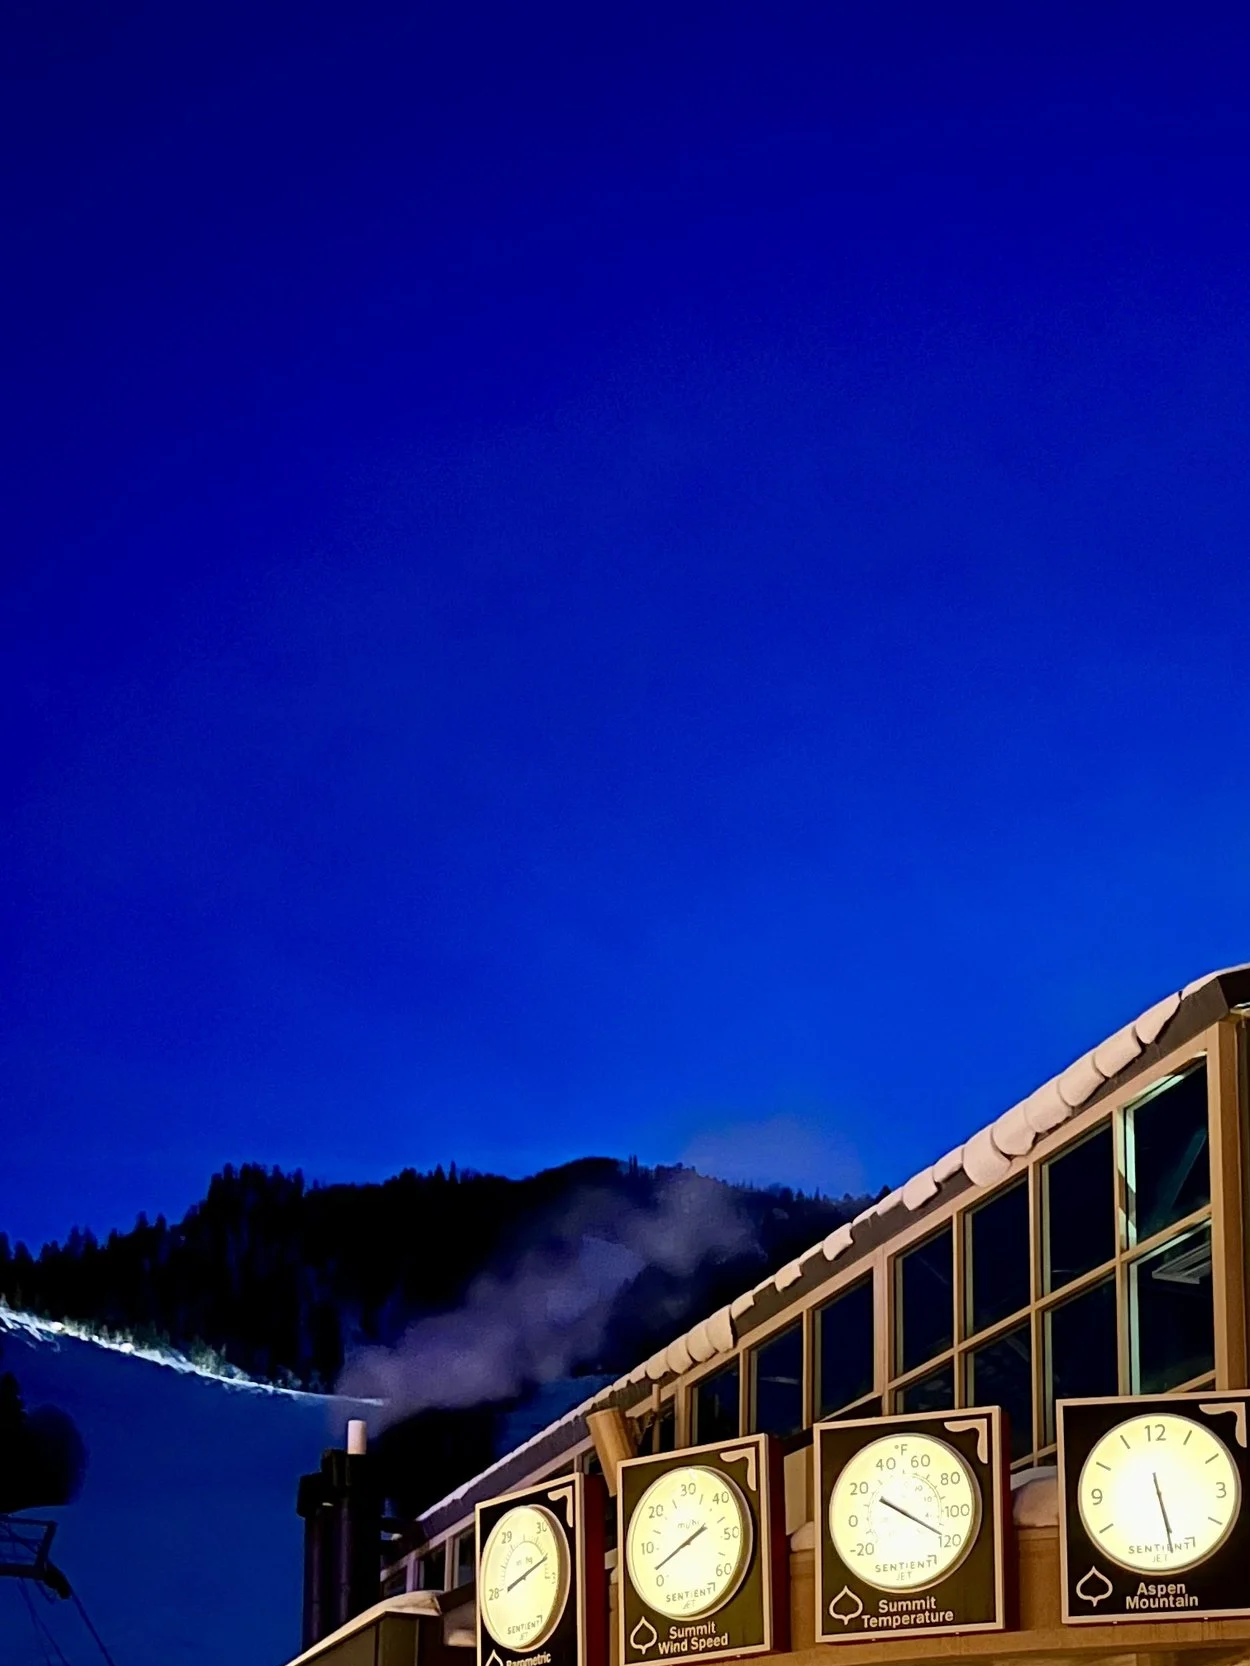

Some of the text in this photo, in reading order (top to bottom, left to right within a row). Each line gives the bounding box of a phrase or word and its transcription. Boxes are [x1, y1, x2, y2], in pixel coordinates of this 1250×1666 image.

[1144, 1424, 1167, 1442] 12
[876, 1457, 897, 1471] 40
[910, 1454, 931, 1468] 60
[940, 1471, 961, 1486] 80
[681, 1482, 697, 1497] 30
[849, 1481, 869, 1496] 20
[1215, 1482, 1227, 1499] 3
[712, 1491, 730, 1505] 40
[1091, 1488, 1103, 1505] 9
[648, 1504, 664, 1519] 20
[944, 1503, 970, 1518] 100
[848, 1514, 859, 1528] 0
[501, 1531, 513, 1545] 29
[723, 1526, 740, 1540] 50
[938, 1533, 962, 1548] 120
[641, 1541, 655, 1555] 10
[849, 1542, 875, 1557] -20
[1129, 1542, 1190, 1555] SENTIENT
[715, 1563, 732, 1577] 60
[875, 1559, 932, 1573] SENTIENT
[656, 1574, 664, 1587] 0
[488, 1588, 500, 1601] 28
[665, 1588, 711, 1603] SENTIENT
[1137, 1582, 1186, 1599] Aspen
[878, 1596, 936, 1614] Summit
[1125, 1593, 1199, 1610] Mountain
[861, 1609, 954, 1629] Temperature
[507, 1620, 540, 1635] SENTIENT
[669, 1621, 716, 1640] Summit
[658, 1632, 729, 1655] Wind Speed
